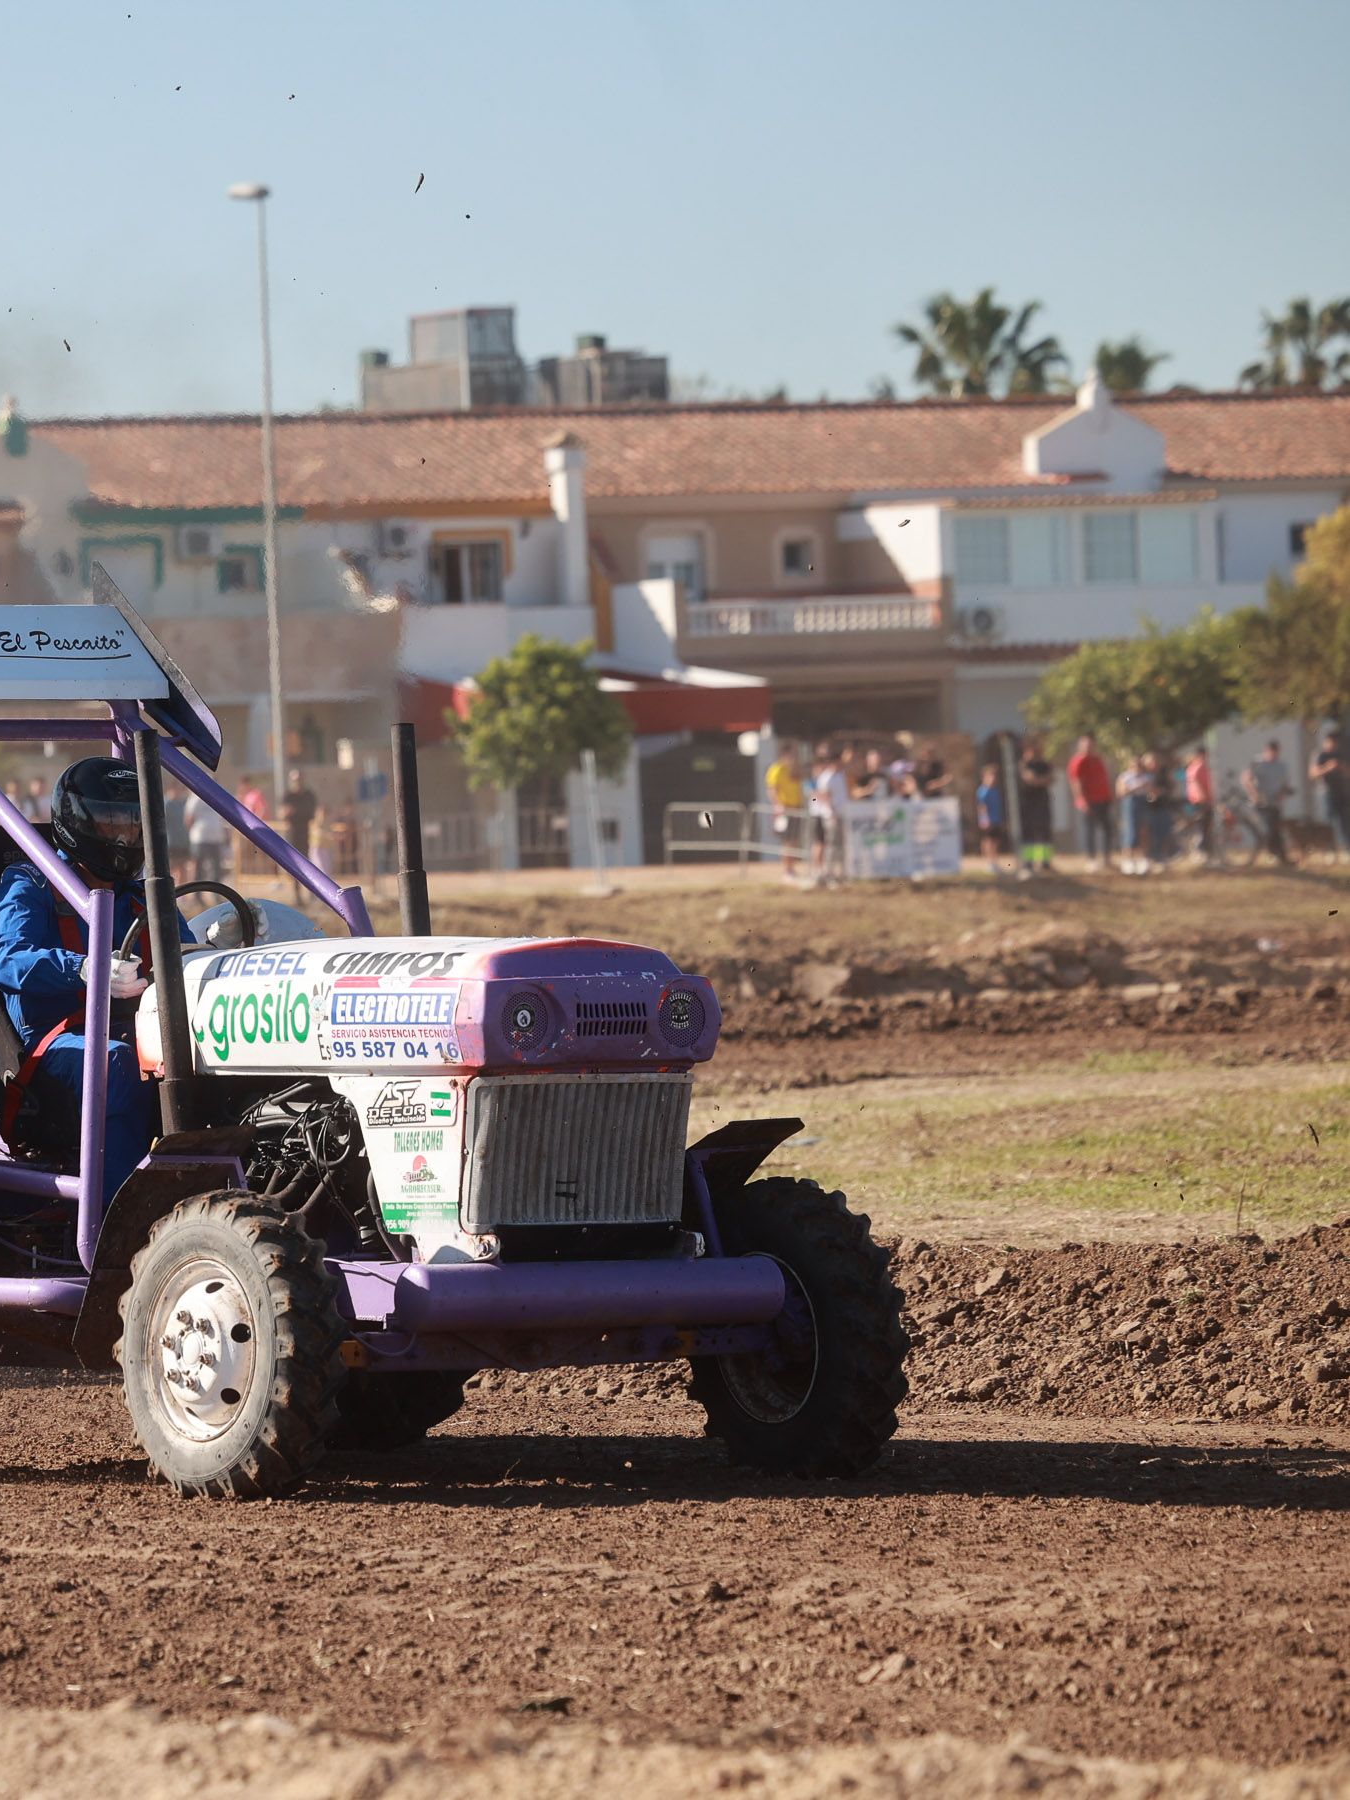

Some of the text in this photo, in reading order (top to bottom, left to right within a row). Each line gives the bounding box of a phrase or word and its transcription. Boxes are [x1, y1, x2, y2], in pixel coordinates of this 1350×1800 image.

[215, 951, 466, 978] DIESEL CAMPOS
[335, 994, 451, 1024] ELECTROTELE
[331, 1029, 367, 1039] SERVICIO
[369, 1028, 417, 1038] ASISTENCIA
[333, 1041, 459, 1059] 95 587 04 16
[368, 1105, 425, 1118] DECOR
[394, 1131, 420, 1153] TALLERES
